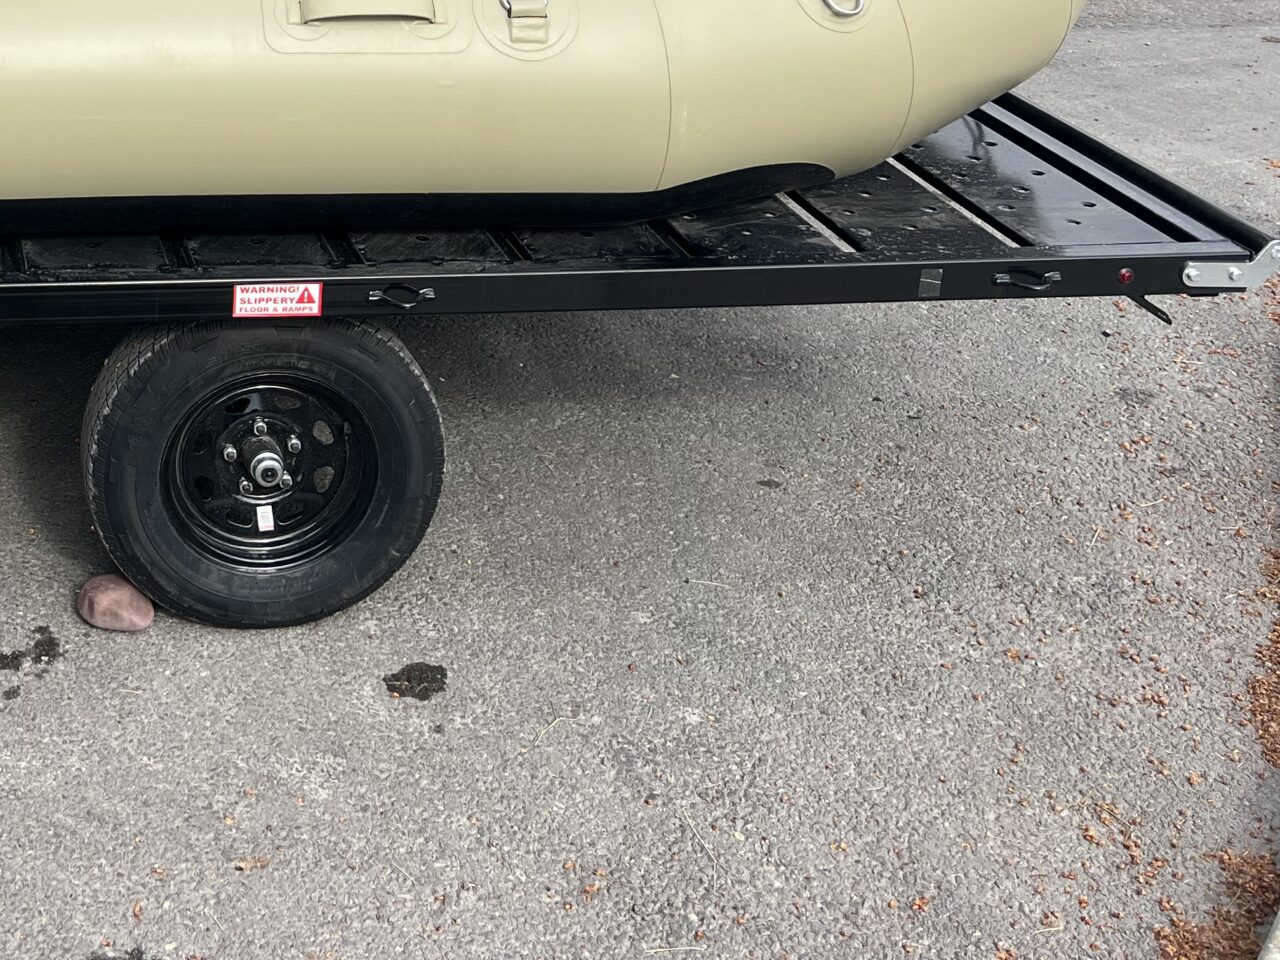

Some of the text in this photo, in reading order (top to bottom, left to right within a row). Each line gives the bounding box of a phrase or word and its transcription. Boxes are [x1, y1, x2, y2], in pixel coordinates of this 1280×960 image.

[239, 285, 300, 295] WARNING!
[239, 296, 296, 305] SLIPPERY
[282, 305, 314, 313] RAMPS
